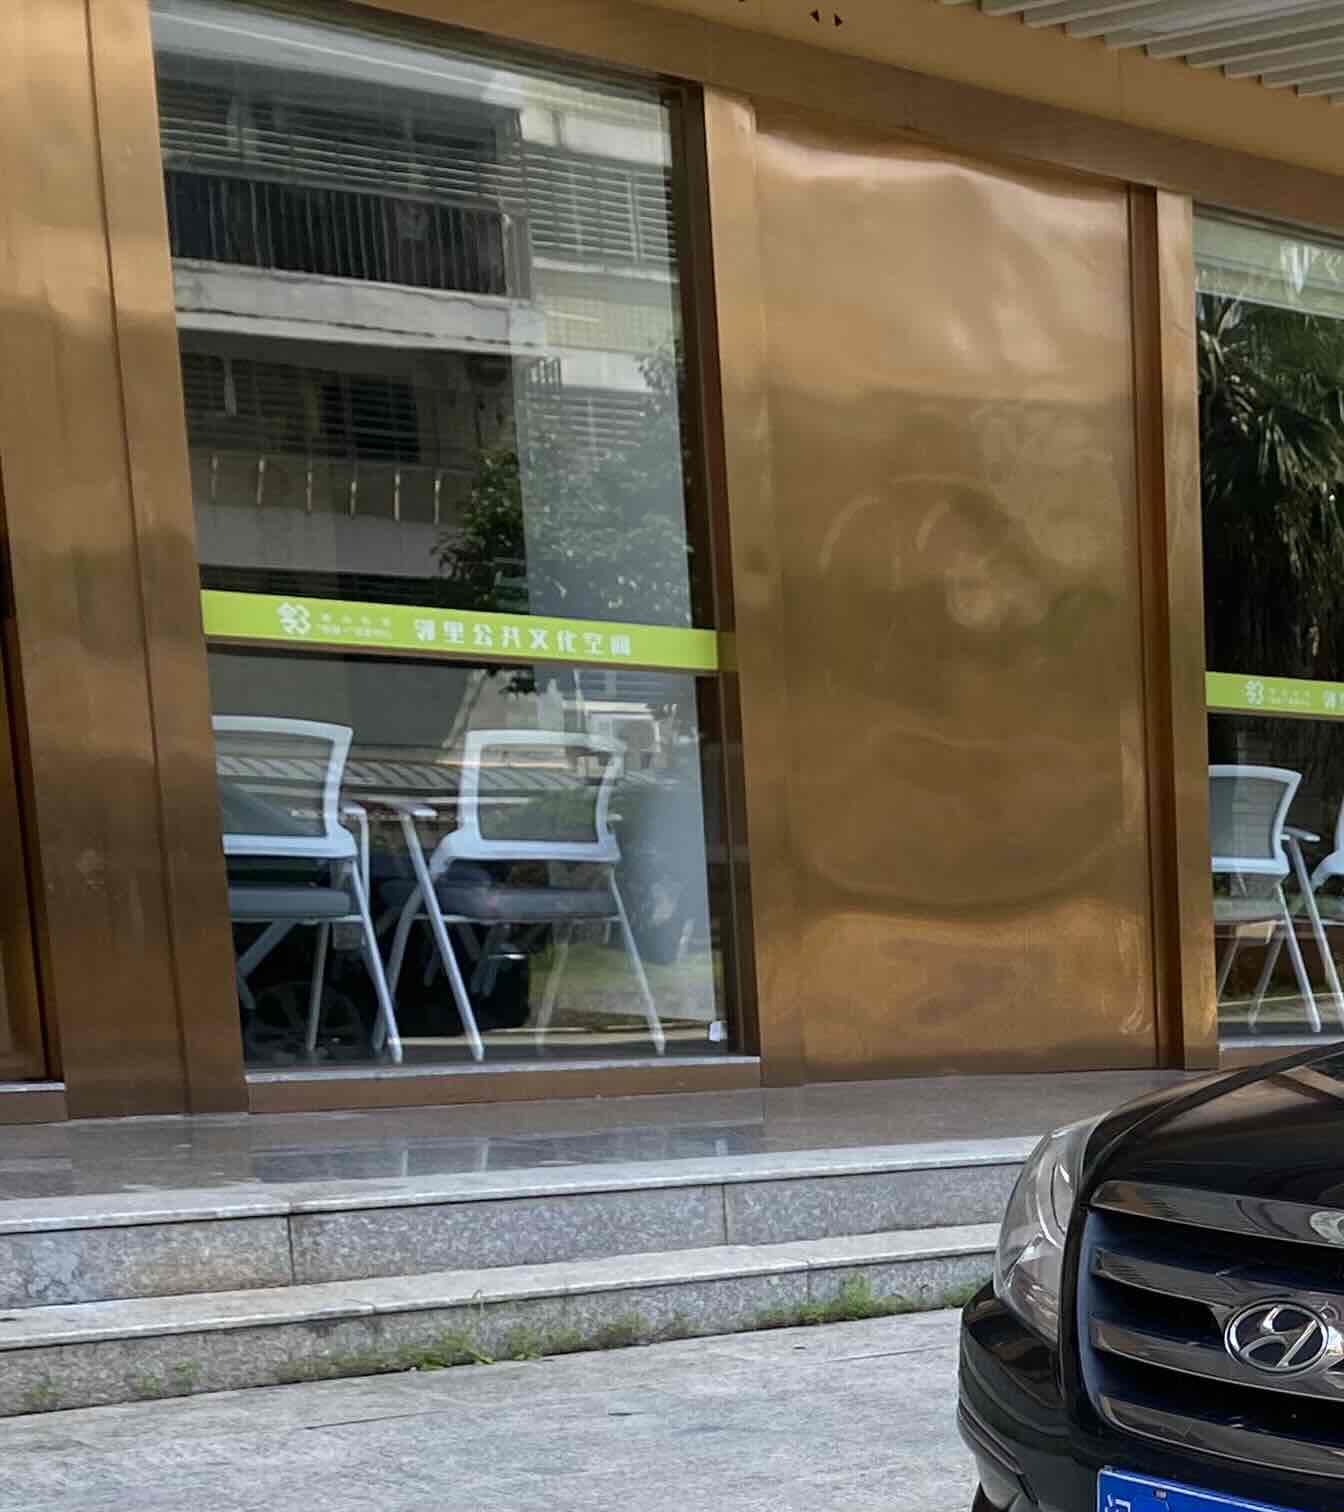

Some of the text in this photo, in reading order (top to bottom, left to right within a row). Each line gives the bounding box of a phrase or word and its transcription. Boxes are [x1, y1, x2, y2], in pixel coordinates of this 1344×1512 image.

[414, 618, 631, 656] 邻里公共文化空间
